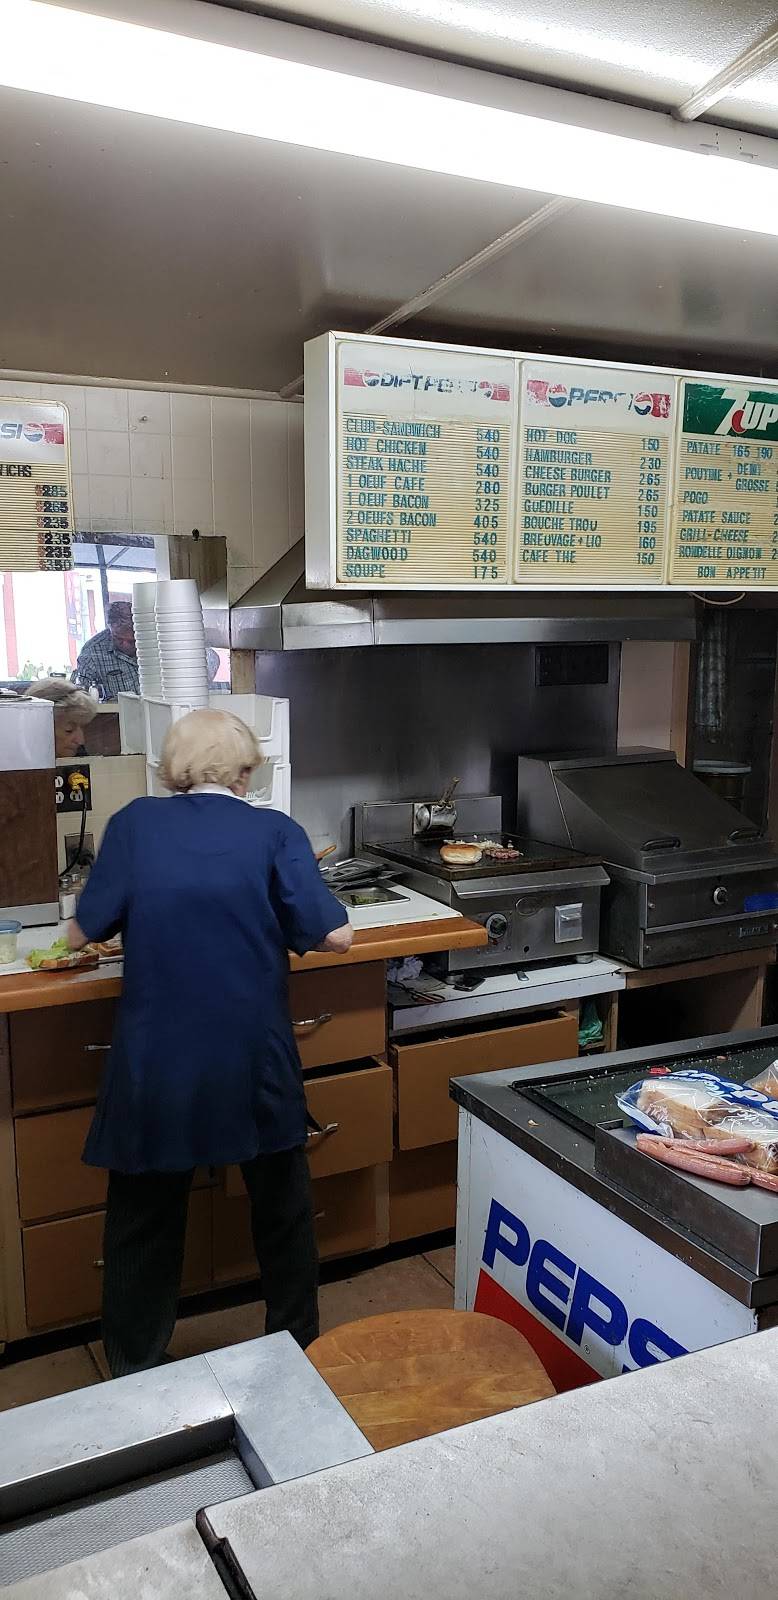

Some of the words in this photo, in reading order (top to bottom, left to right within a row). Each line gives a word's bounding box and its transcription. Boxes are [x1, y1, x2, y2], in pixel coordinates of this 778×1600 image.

[476, 428, 500, 442] 540
[347, 436, 368, 451] HOT
[377, 439, 426, 455] CHICKEN
[476, 446, 500, 460] 540
[642, 438, 660, 451] 150
[687, 441, 721, 455] PATATE
[733, 445, 751, 457] 165
[758, 447, 773, 459] 190
[347, 455, 384, 471] STEAK
[388, 457, 427, 473] HACHE
[476, 463, 500, 477] 540
[526, 448, 593, 465] HAMBURGER
[640, 457, 661, 469] 230
[525, 465, 566, 480] CHEESE
[571, 468, 612, 482] BURGER
[639, 473, 661, 486] 265
[685, 467, 722, 481] POUTINE
[737, 463, 761, 475] DEMI
[359, 474, 386, 489] OEUF
[395, 476, 425, 491] CAFE
[476, 481, 500, 494] 280
[525, 482, 566, 497] BURGER
[571, 484, 610, 499] POULET
[639, 489, 660, 501] 265
[736, 478, 770, 491] GROSSE
[358, 492, 387, 507] OEUF
[393, 494, 429, 509] BACON
[475, 498, 500, 512] 325
[684, 491, 708, 504] POGO
[524, 500, 574, 514] GUEDILLE
[639, 505, 659, 517] 150
[682, 510, 715, 523] PATATE
[722, 512, 752, 524] SAUCE
[346, 510, 353, 524] 2
[357, 510, 394, 525] OEUFS
[400, 512, 437, 527] BACON
[474, 515, 499, 529] 405
[524, 516, 564, 530] BOUCHE
[570, 518, 598, 531] TROU
[637, 521, 657, 533] 195
[346, 528, 412, 543] SPAGHETTI
[473, 532, 497, 546] 540
[639, 537, 656, 549] 160
[346, 546, 408, 561] DAGWOOD
[472, 549, 497, 563] 540
[522, 549, 549, 562] CAFE
[556, 550, 576, 563] THE
[637, 552, 655, 565] 150
[727, 547, 763, 559] OIGNON
[345, 563, 386, 578] SOUPE
[473, 566, 498, 580] 175
[697, 566, 716, 578] BON
